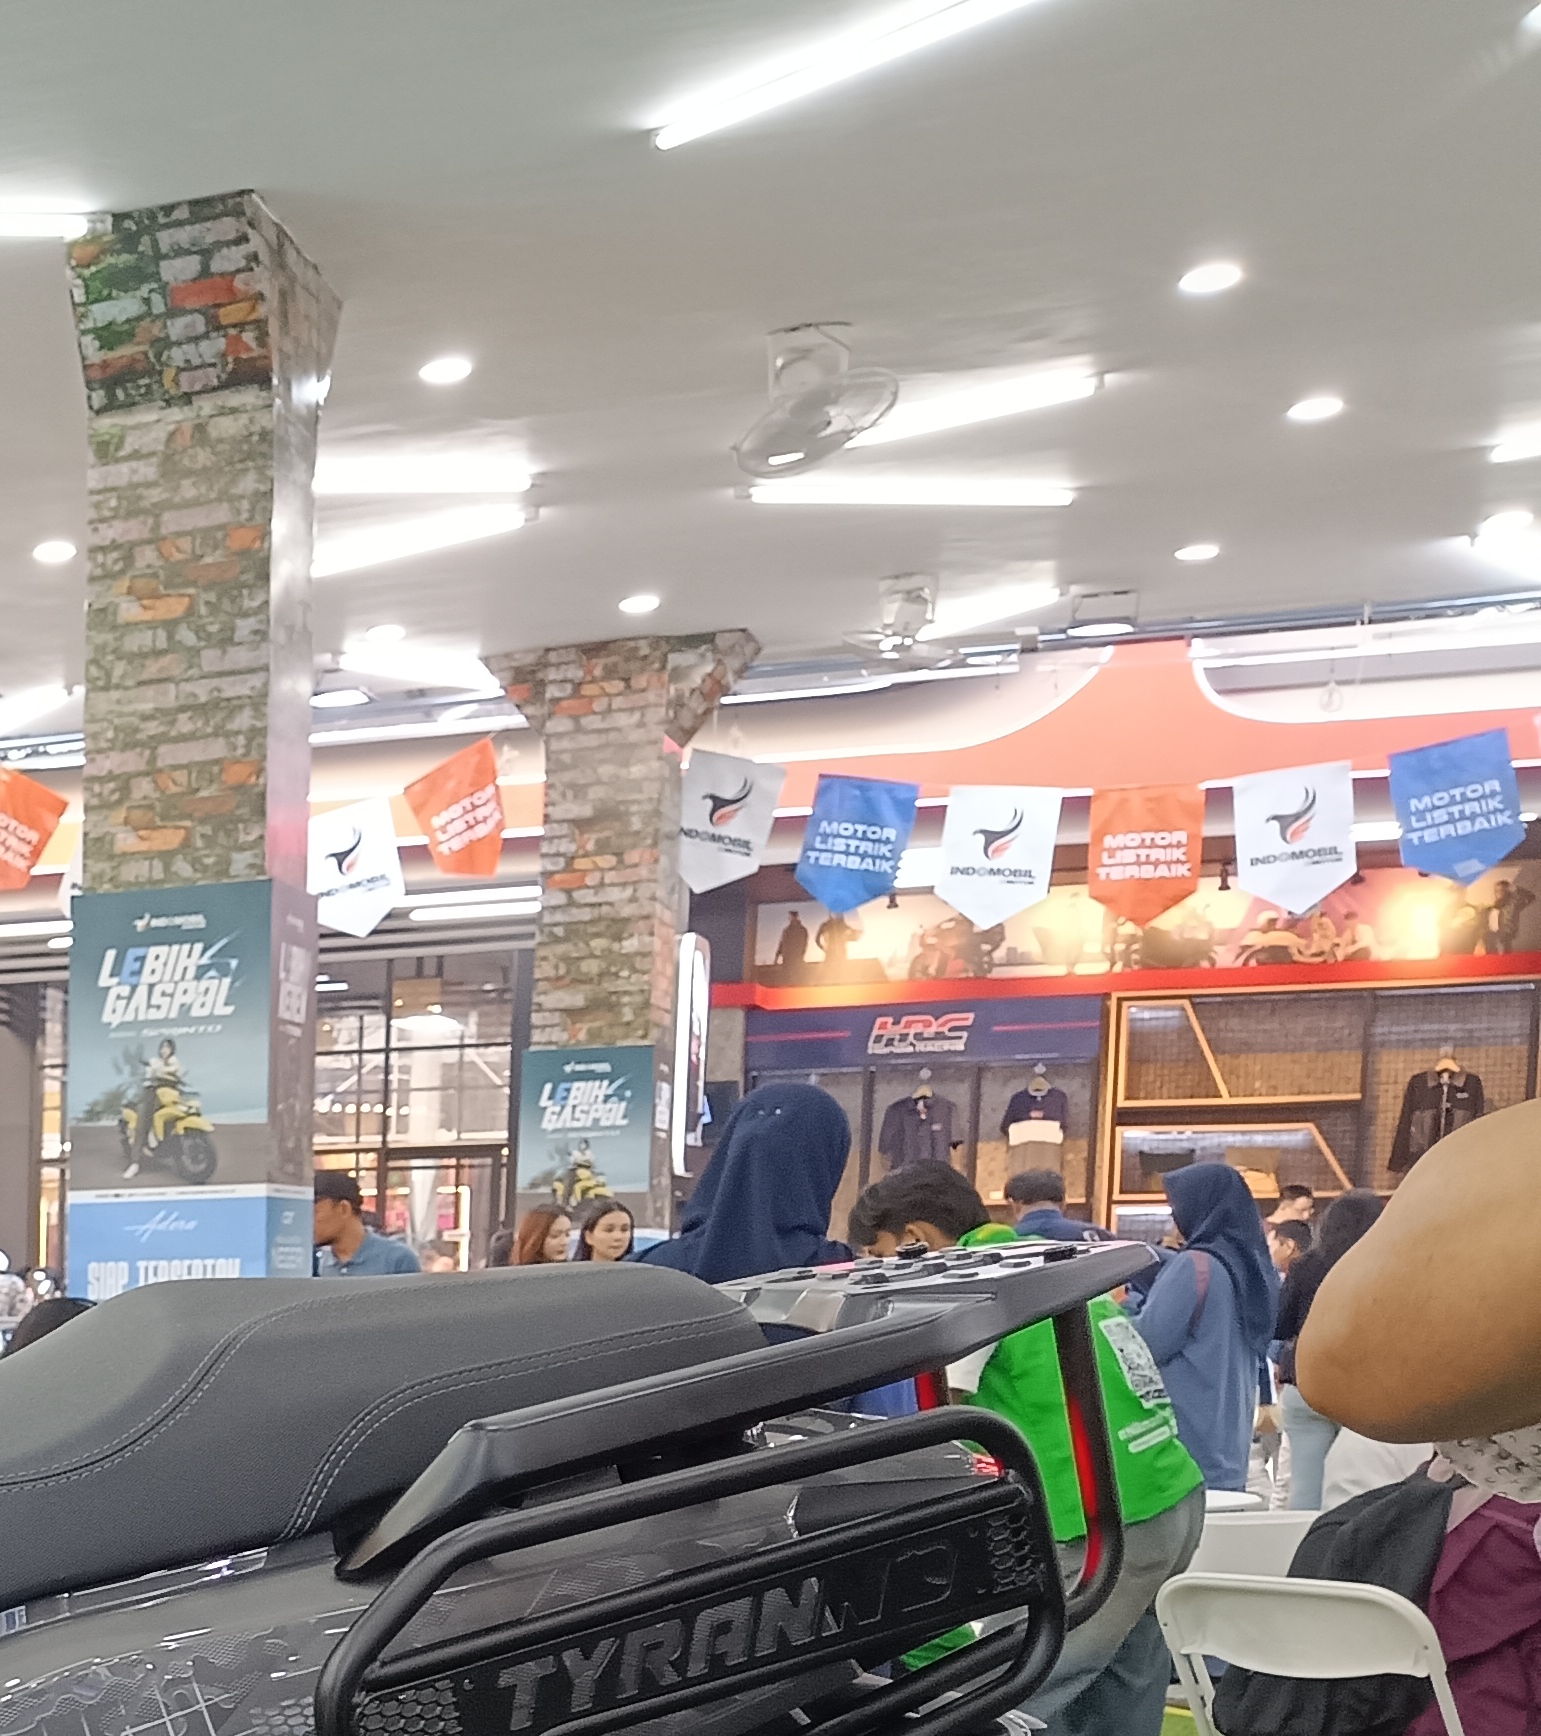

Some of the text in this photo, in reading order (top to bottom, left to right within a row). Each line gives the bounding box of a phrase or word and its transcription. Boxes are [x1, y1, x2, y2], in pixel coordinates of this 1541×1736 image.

[1408, 778, 1502, 813] MOTOR
[1409, 795, 1505, 829] LISTRIK
[679, 826, 754, 852] NDOMOBIL
[818, 819, 897, 843] MOTOR
[1103, 830, 1189, 849] MOTOR
[1405, 810, 1515, 846] TERBAIK
[815, 835, 894, 858] LISTRIK
[1100, 847, 1188, 865] LISTRIK
[1249, 846, 1344, 867] INDOMOBIL
[806, 850, 896, 875] TERBAIK
[949, 866, 1036, 879] INDOMOBIL
[1096, 862, 1193, 881] TERBAIK
[318, 873, 388, 899] NDOMOBIL
[97, 942, 205, 988] LEBIH
[100, 977, 236, 1029] GASPOL
[869, 1012, 975, 1046] HRC
[539, 1080, 610, 1108] LEBIH
[540, 1100, 630, 1131] GASPOL
